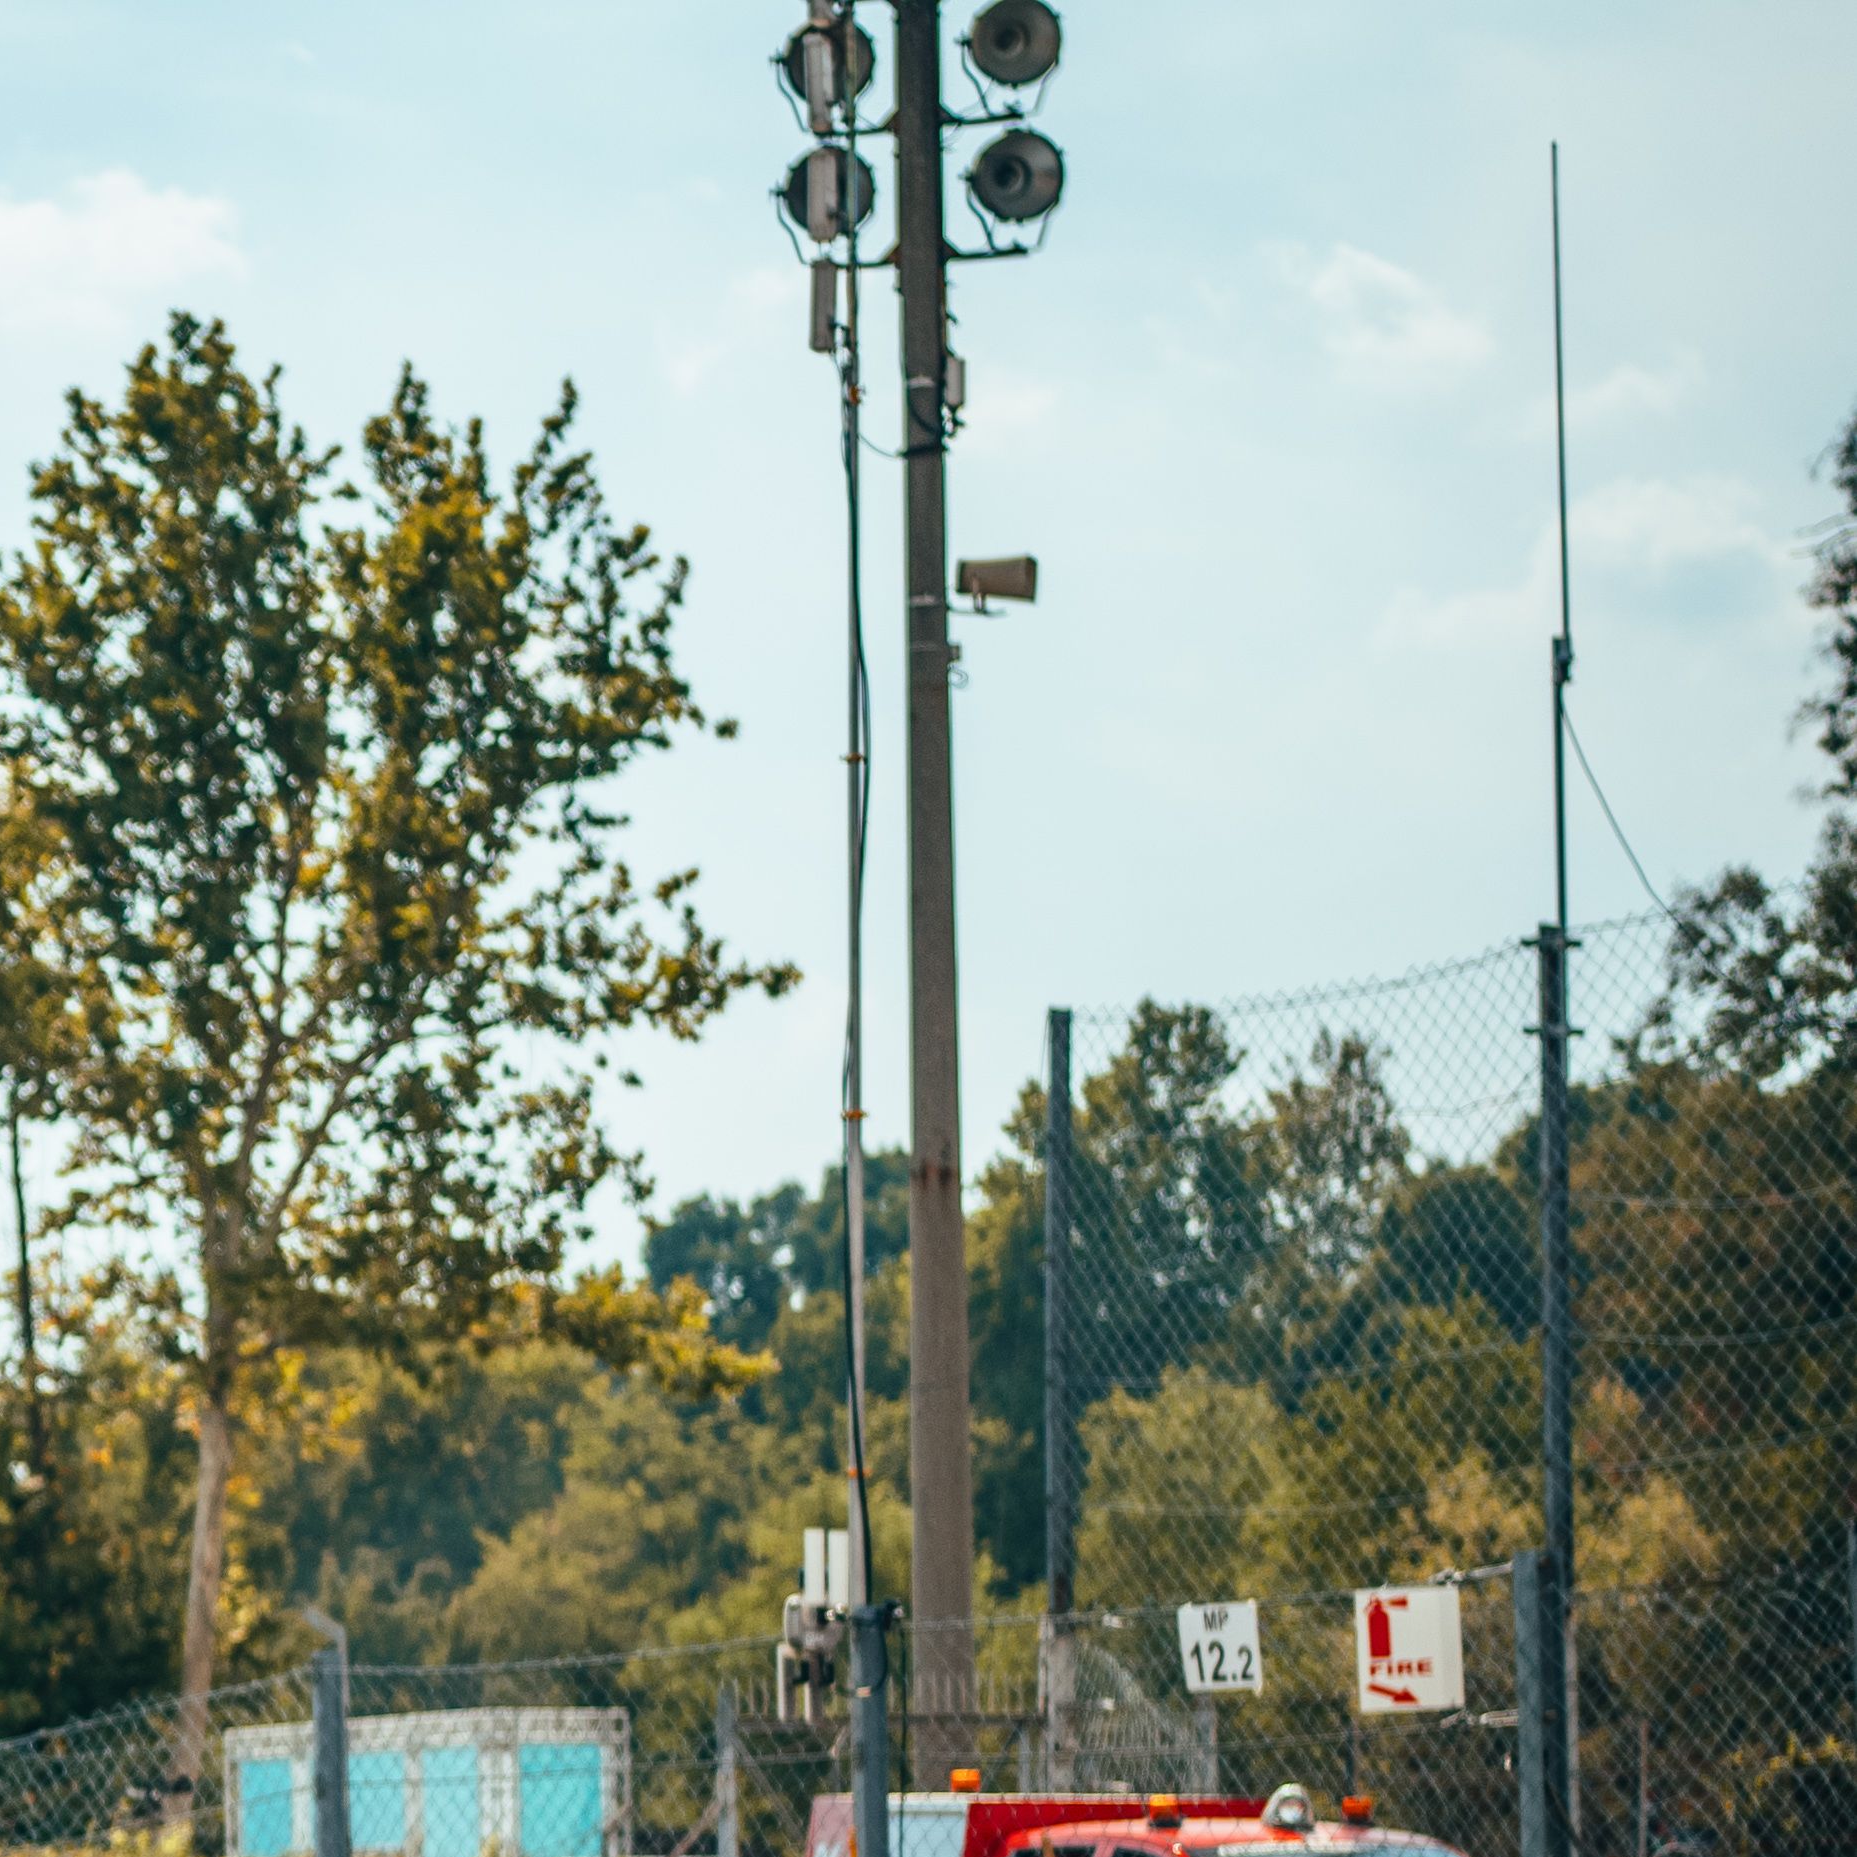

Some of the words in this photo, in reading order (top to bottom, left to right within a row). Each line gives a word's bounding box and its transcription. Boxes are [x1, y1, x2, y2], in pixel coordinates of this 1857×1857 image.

[1203, 1610, 1229, 1632] MP
[1191, 1640, 1254, 1683] 12.2
[1370, 1658, 1433, 1677] FIRE
